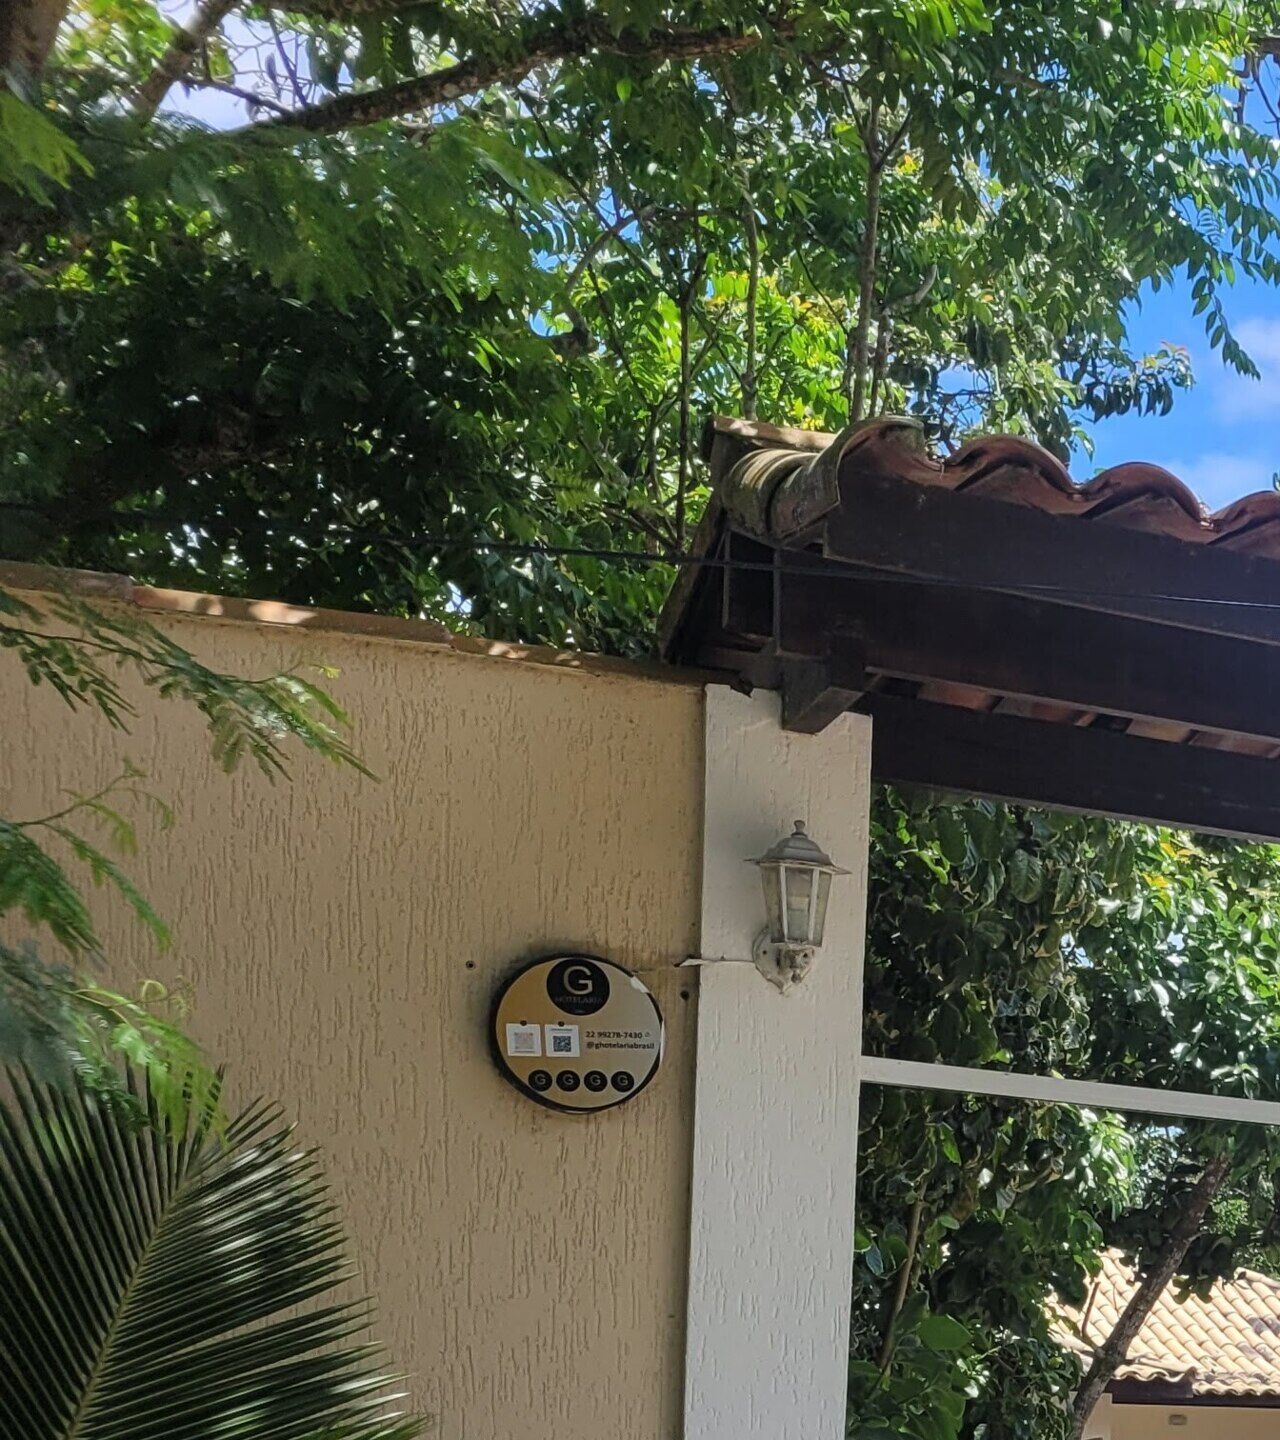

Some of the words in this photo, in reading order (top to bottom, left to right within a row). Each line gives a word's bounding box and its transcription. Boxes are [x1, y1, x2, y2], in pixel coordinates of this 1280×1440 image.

[564, 966, 592, 994] G
[535, 1074, 546, 1084] G
[562, 1074, 574, 1085] G
[589, 1074, 601, 1085] G
[617, 1075, 628, 1086] G
